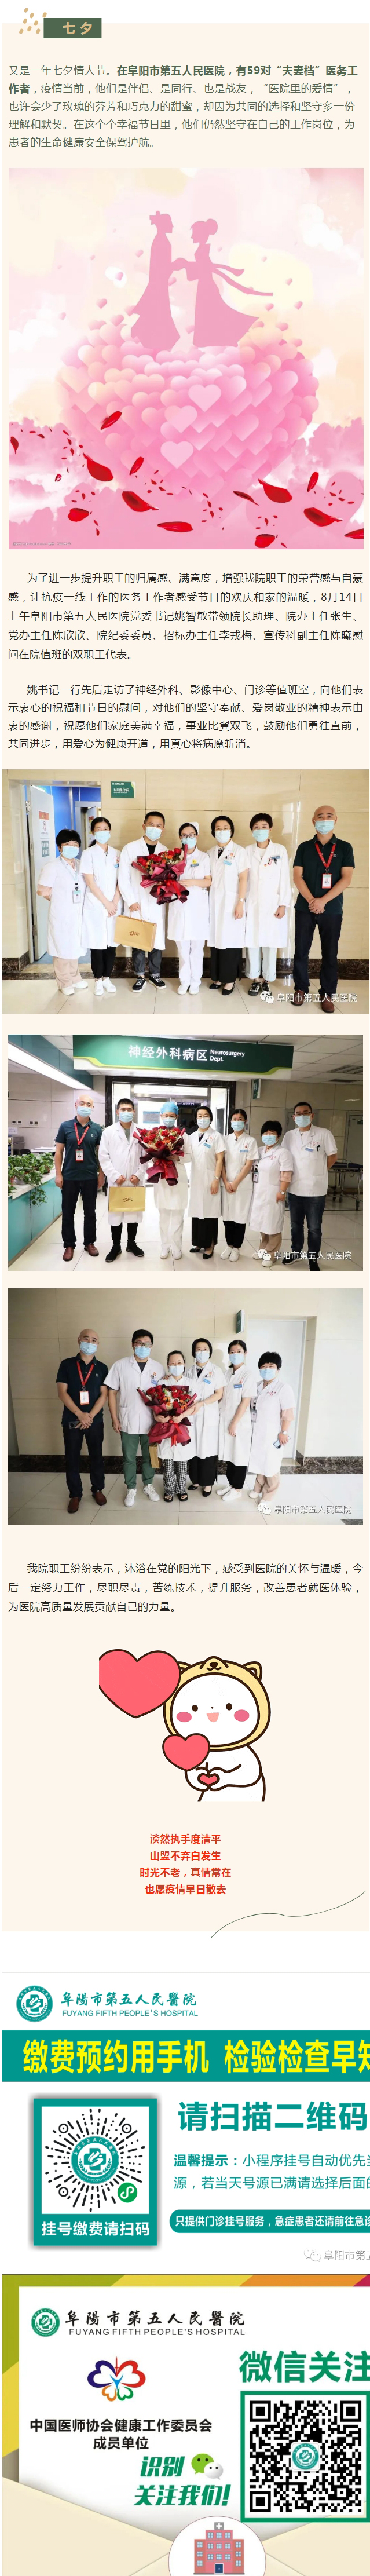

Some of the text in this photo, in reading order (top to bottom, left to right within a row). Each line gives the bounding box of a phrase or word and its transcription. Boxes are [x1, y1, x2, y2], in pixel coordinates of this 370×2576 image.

[63, 21, 92, 35] 七夕
[9, 101, 354, 112] 也许会少了玫瑰的芬芳和巧克力的甜蜜，却因为共同的选择和坚守多一份
[9, 119, 354, 130] 理解和默契。在这个个幸福节日里，他们仍然坚守在自己的工作岗位，为
[9, 137, 153, 147] 患者的生命健康安全保驾护航。
[27, 573, 363, 583] 为了进一步提升职工的归属感、满意度，增强我院职工的荣誉感与自豪
[8, 592, 362, 602] 感，让抗疫一线工作的医务工作者感受节日的欢庆和家的温暖，8月14日
[8, 611, 356, 622] 上午阜阳市第五人民医院党委书记姚智敏带领院长助理、院办主任张生、
[9, 649, 130, 659] 问在院值班的双职工代表。
[27, 684, 363, 695] 姚书记一行先后走访了神经外科、影像中心、门诊等值班室，向他们表
[8, 702, 362, 713] 示衷心的祝福和节日的慰问，对他们的坚守奉献、爱岗敬业的精神表示由
[8, 721, 358, 731] 衷的感谢，祝愿他们家庭美满幸福，事业比翼双飞，鼓励他们勇往直前，
[8, 738, 250, 749] 共同进步，用爱心为健康开道，用真心将病魔斩消。
[128, 1045, 207, 1061] 神经外科病区
[210, 1049, 245, 1057] Neurosurgery
[27, 1563, 363, 1574] 我院职工纷纷表示，沐浴在党的阳光下，感受到医院的关怀与温暖，今
[8, 1582, 358, 1593] 后一定努力工作，尽职尽责，苦练技术，提升服务，改善患者就医体验，
[8, 1601, 174, 1612] 为医院高质量发展贡献自己的力量。
[150, 1834, 221, 1844] 淡然执手度清平
[151, 1851, 221, 1861] 山盟不弃白发生
[140, 1868, 231, 1877] 时光不老，真情常在
[145, 1884, 226, 1894] 也愿疫情早日散去
[61, 1992, 196, 2007] 阜陽市第五人民醫院
[23, 2039, 209, 2074] 缴费预约用手机
[178, 2101, 367, 2131] 请扫描二维码
[174, 2154, 370, 2167] 温馨提示：小程序挂号自动优先
[174, 2176, 370, 2190] 源，若当天号源已满请选择后面
[42, 2222, 150, 2237] 挂号缴费请扫码
[65, 2310, 244, 2327] 阜陽市第五人民醫院
[239, 2350, 370, 2383] 微信关注
[30, 2418, 212, 2432] 中国医师协会健康工作委员会
[93, 2436, 149, 2450] 成员单位
[140, 2456, 185, 2478] 识别
